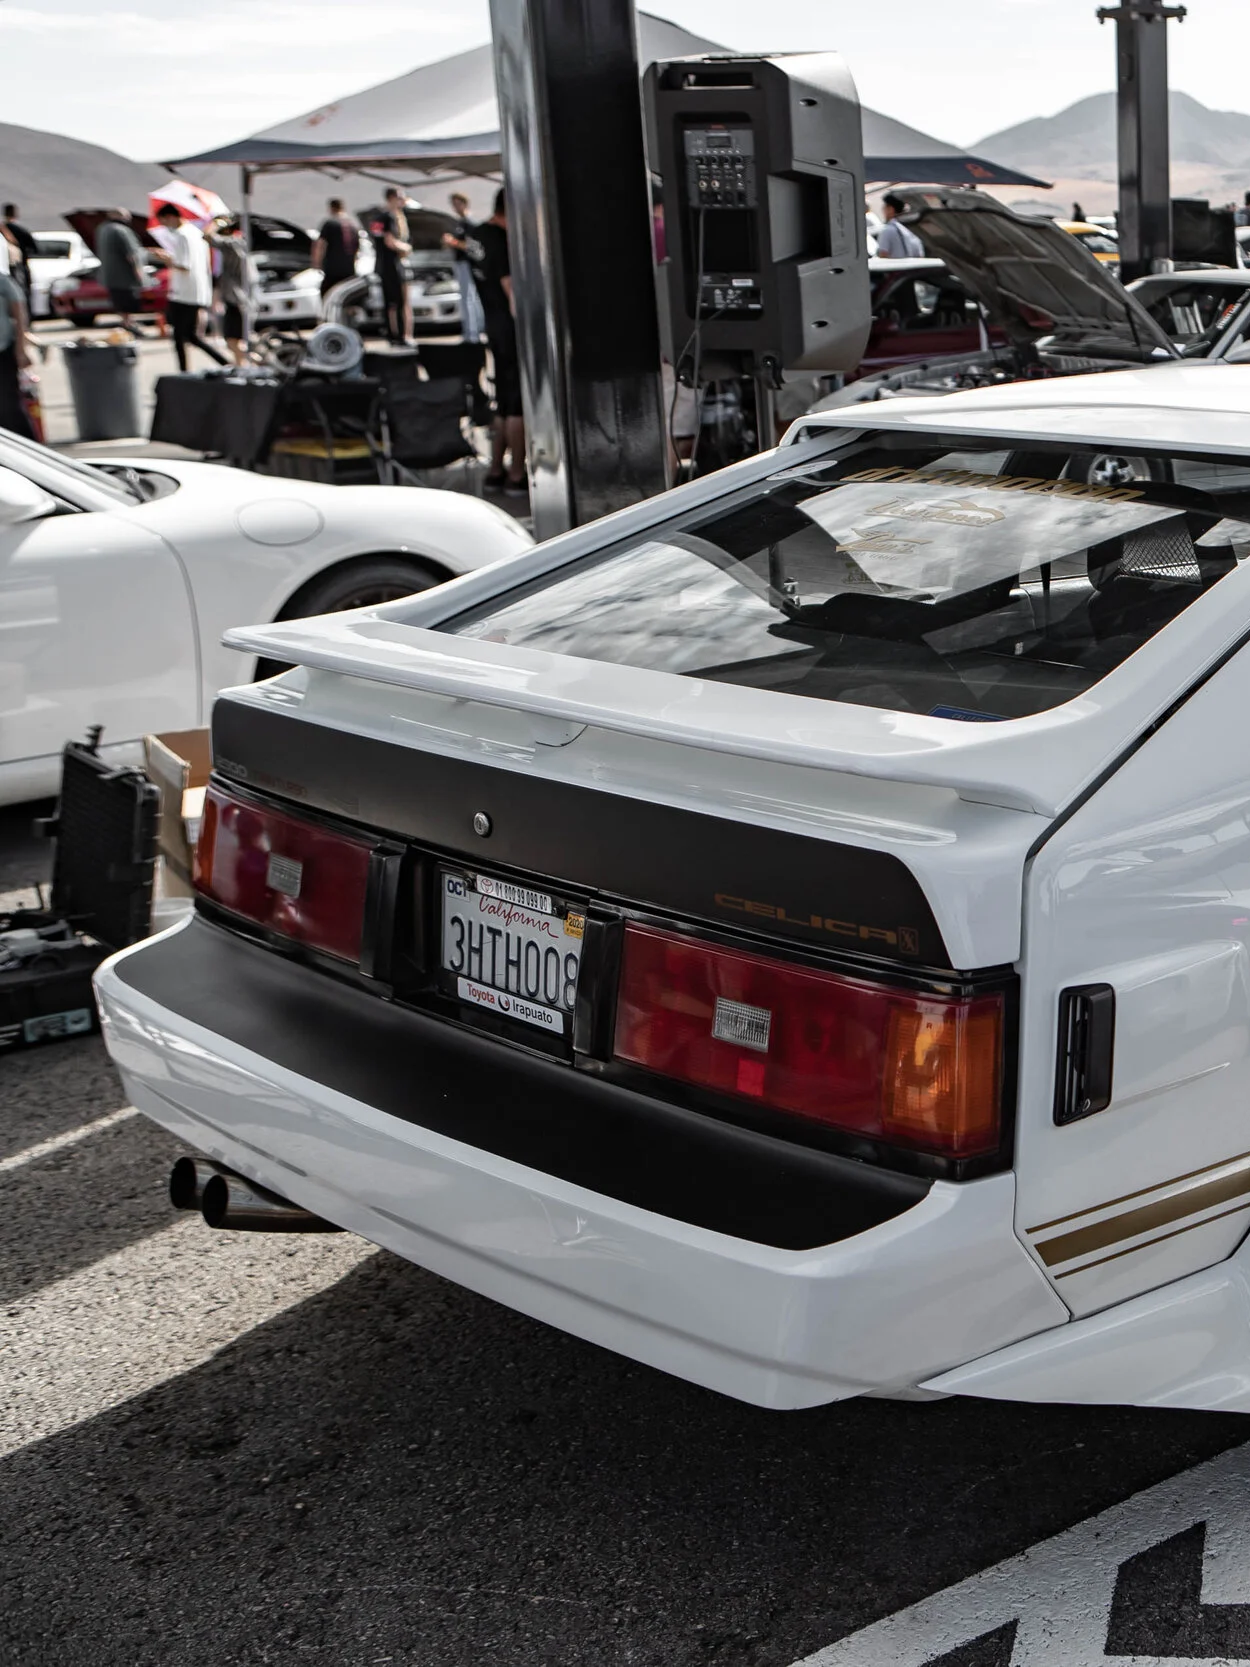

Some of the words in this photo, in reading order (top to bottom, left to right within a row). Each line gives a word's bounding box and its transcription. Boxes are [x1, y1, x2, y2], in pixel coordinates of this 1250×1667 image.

[478, 894, 559, 939] California
[568, 917, 584, 931] 2020
[714, 893, 898, 945] CELICA
[449, 914, 579, 1012] 3HTH008
[466, 983, 496, 1004] Toyota
[512, 998, 553, 1024] Irapuato
